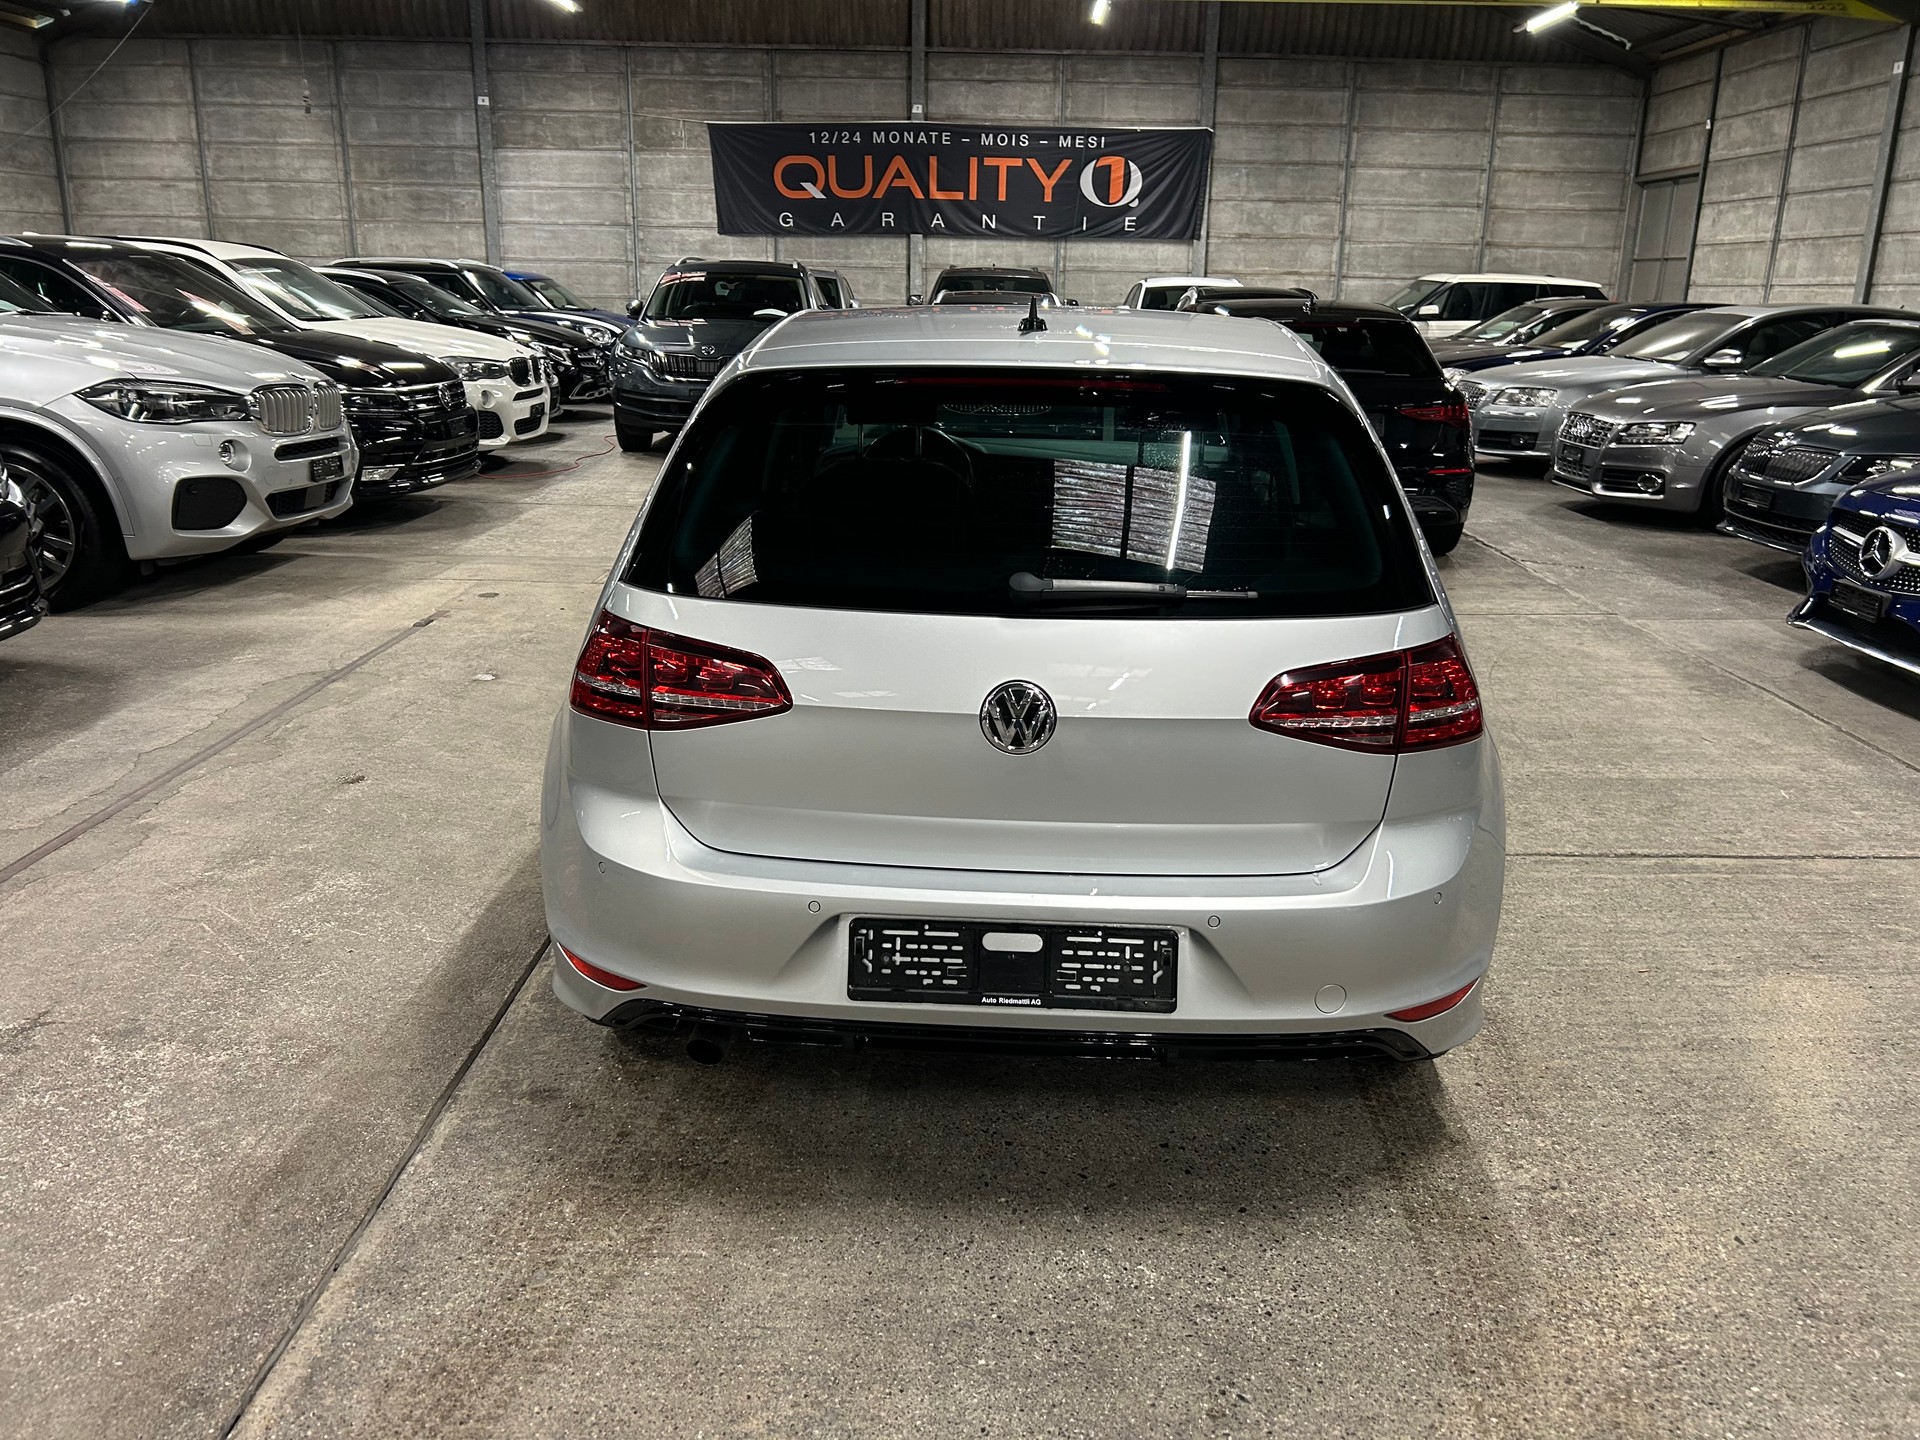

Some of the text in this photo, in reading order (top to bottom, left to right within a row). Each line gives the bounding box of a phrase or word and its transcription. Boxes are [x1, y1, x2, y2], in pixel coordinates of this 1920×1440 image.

[809, 131, 861, 144] 12/24
[872, 131, 951, 145] MONATE
[980, 133, 1029, 147] MOIS
[1058, 135, 1105, 149] MESI
[774, 155, 1072, 202] QUALITY
[779, 212, 1136, 232] GARANTIE
[981, 996, 997, 1004] Auto
[1031, 998, 1042, 1006] AG
